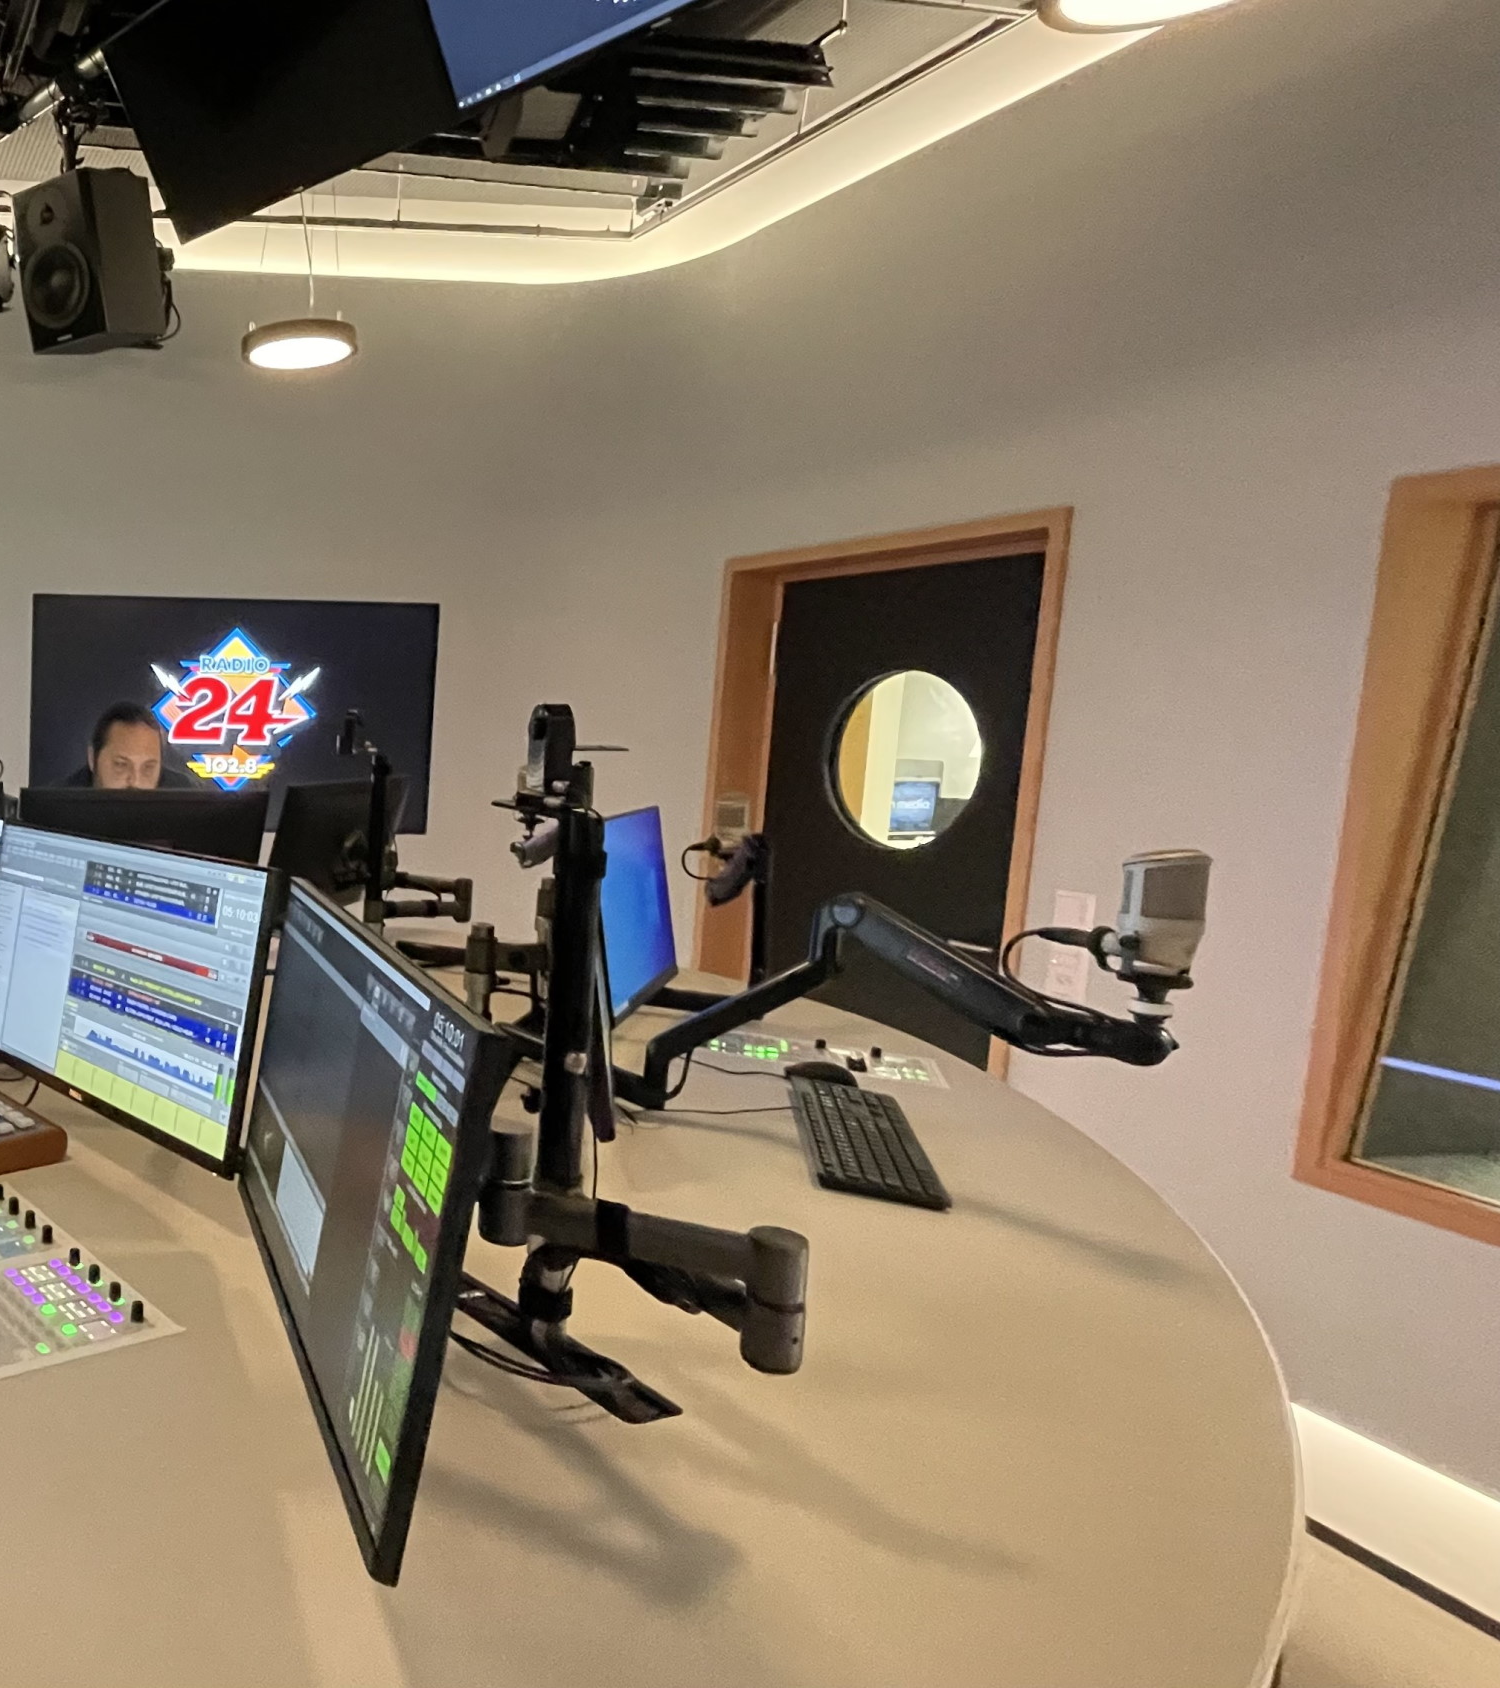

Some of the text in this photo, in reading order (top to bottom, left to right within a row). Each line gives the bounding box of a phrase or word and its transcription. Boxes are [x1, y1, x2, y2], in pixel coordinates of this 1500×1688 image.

[200, 656, 270, 674] RADIO
[168, 675, 296, 745] 24
[204, 756, 259, 774] 102.8
